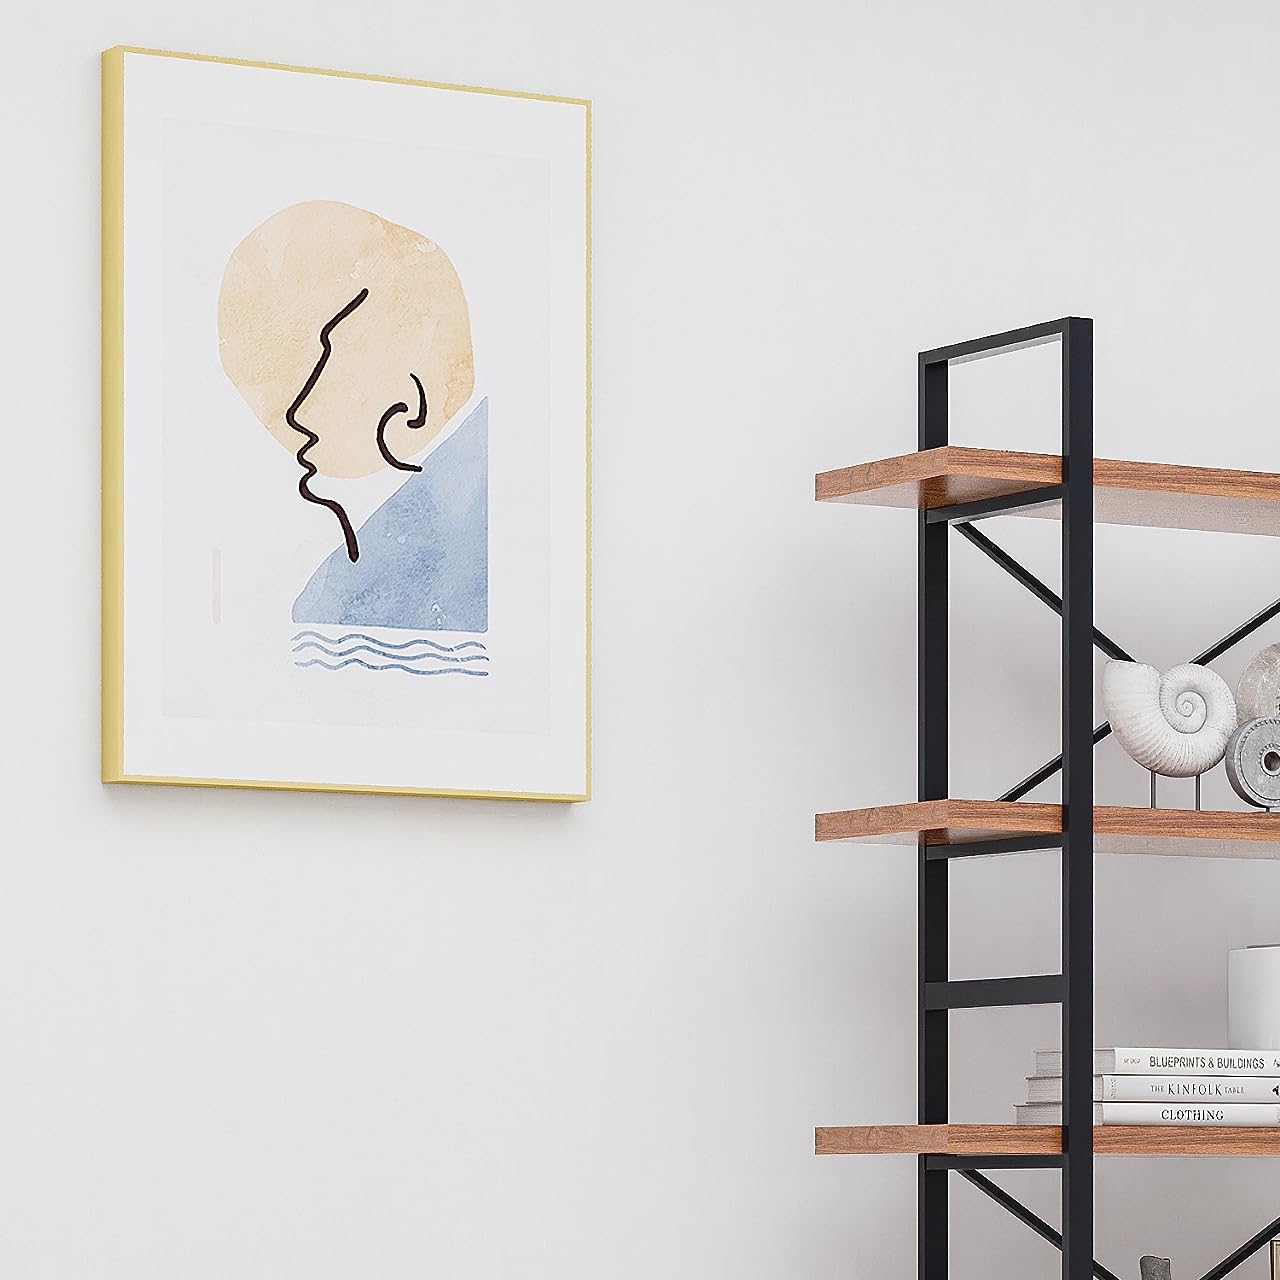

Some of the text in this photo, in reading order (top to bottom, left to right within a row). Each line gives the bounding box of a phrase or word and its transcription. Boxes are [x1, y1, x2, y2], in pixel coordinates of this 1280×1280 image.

[1150, 1056, 1206, 1069] BLUEPRINTS
[1207, 1057, 1215, 1069] &
[1217, 1057, 1265, 1070] BUILDINGS
[1151, 1083, 1245, 1096] THE KINFOLK TABLE
[1161, 1109, 1224, 1121] CLOTHING
